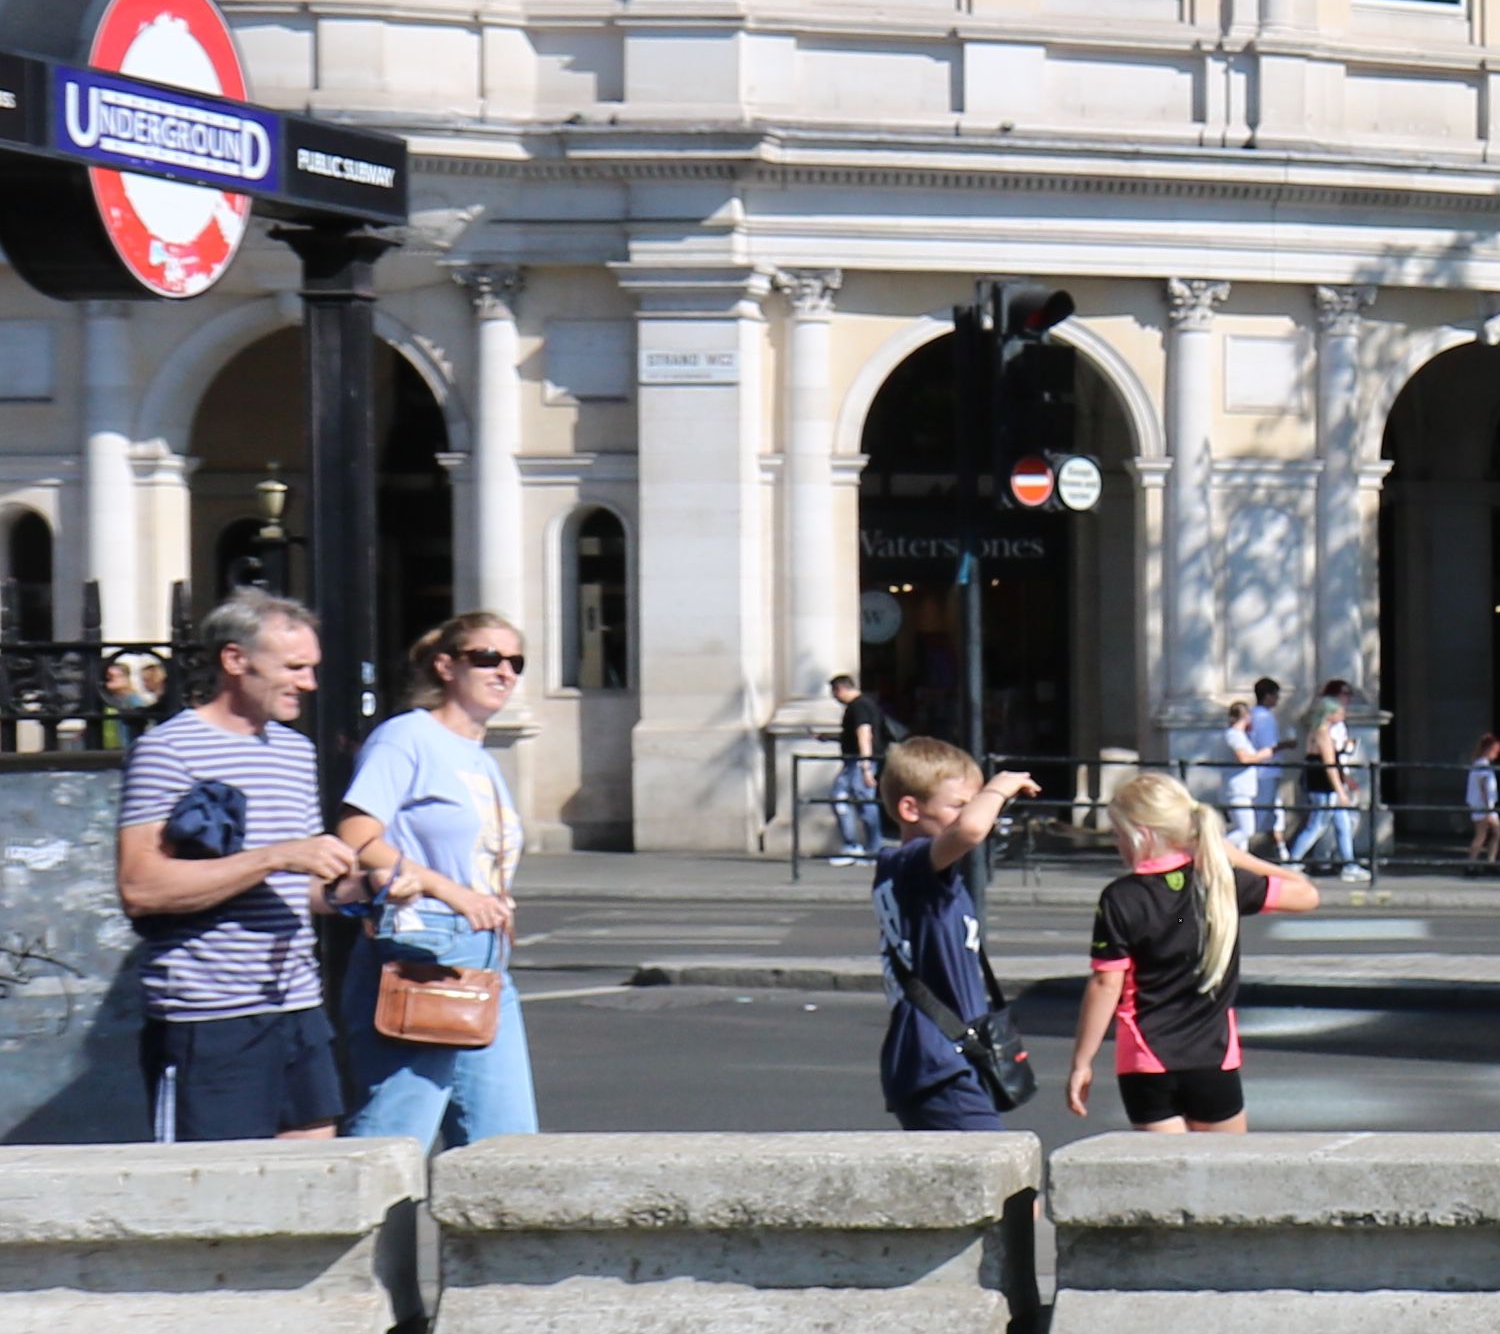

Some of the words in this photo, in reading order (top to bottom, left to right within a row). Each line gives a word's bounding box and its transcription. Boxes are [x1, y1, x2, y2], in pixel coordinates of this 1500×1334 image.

[65, 81, 271, 181] UNDERGROUND
[297, 147, 345, 176] PUBLIC
[343, 156, 396, 189] SUBWAY
